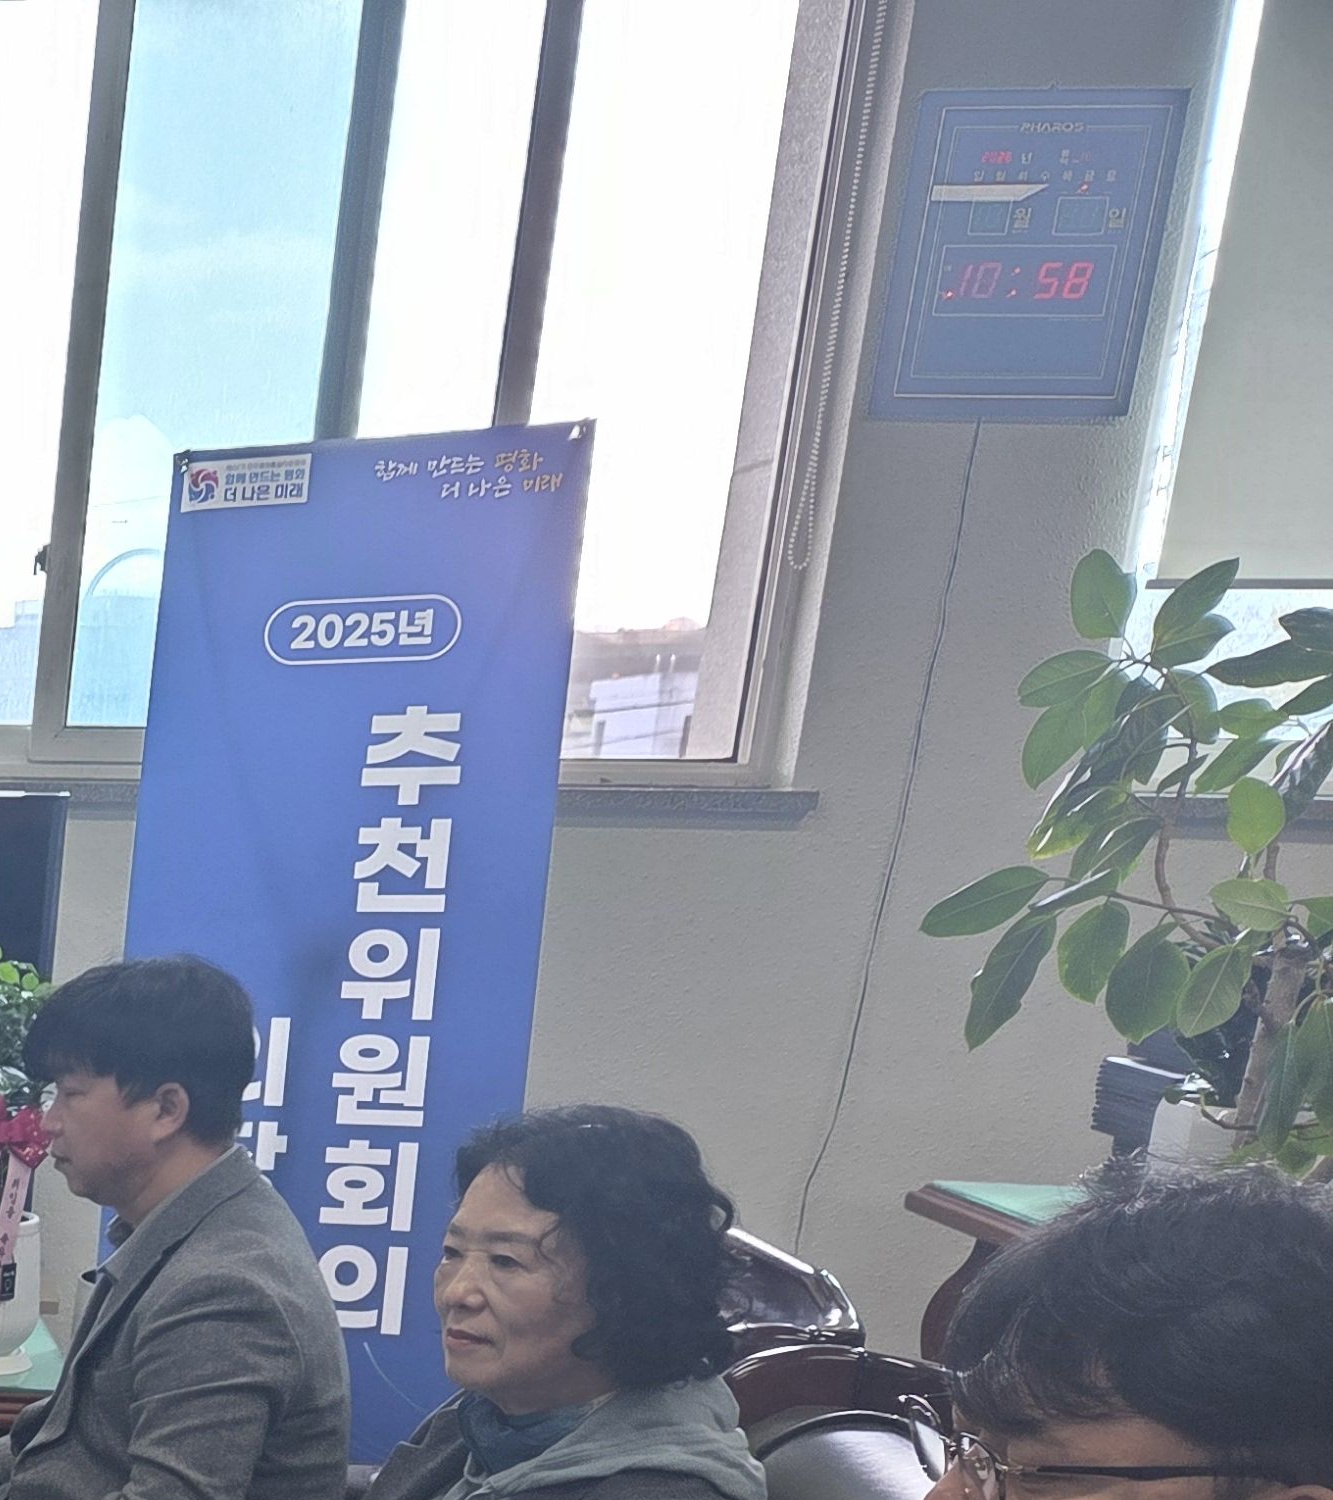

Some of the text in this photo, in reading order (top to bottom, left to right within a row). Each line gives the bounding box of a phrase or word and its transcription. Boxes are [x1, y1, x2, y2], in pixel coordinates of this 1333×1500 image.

[1020, 122, 1085, 133] PHAROS
[959, 262, 1094, 299] 10:58
[374, 449, 543, 482] 함께 만드는 평화
[224, 483, 304, 502] 더 나은 미래
[441, 472, 563, 499] 더 나은 미래
[290, 608, 434, 650] 2025년
[318, 705, 461, 1336] 추천위원회의
